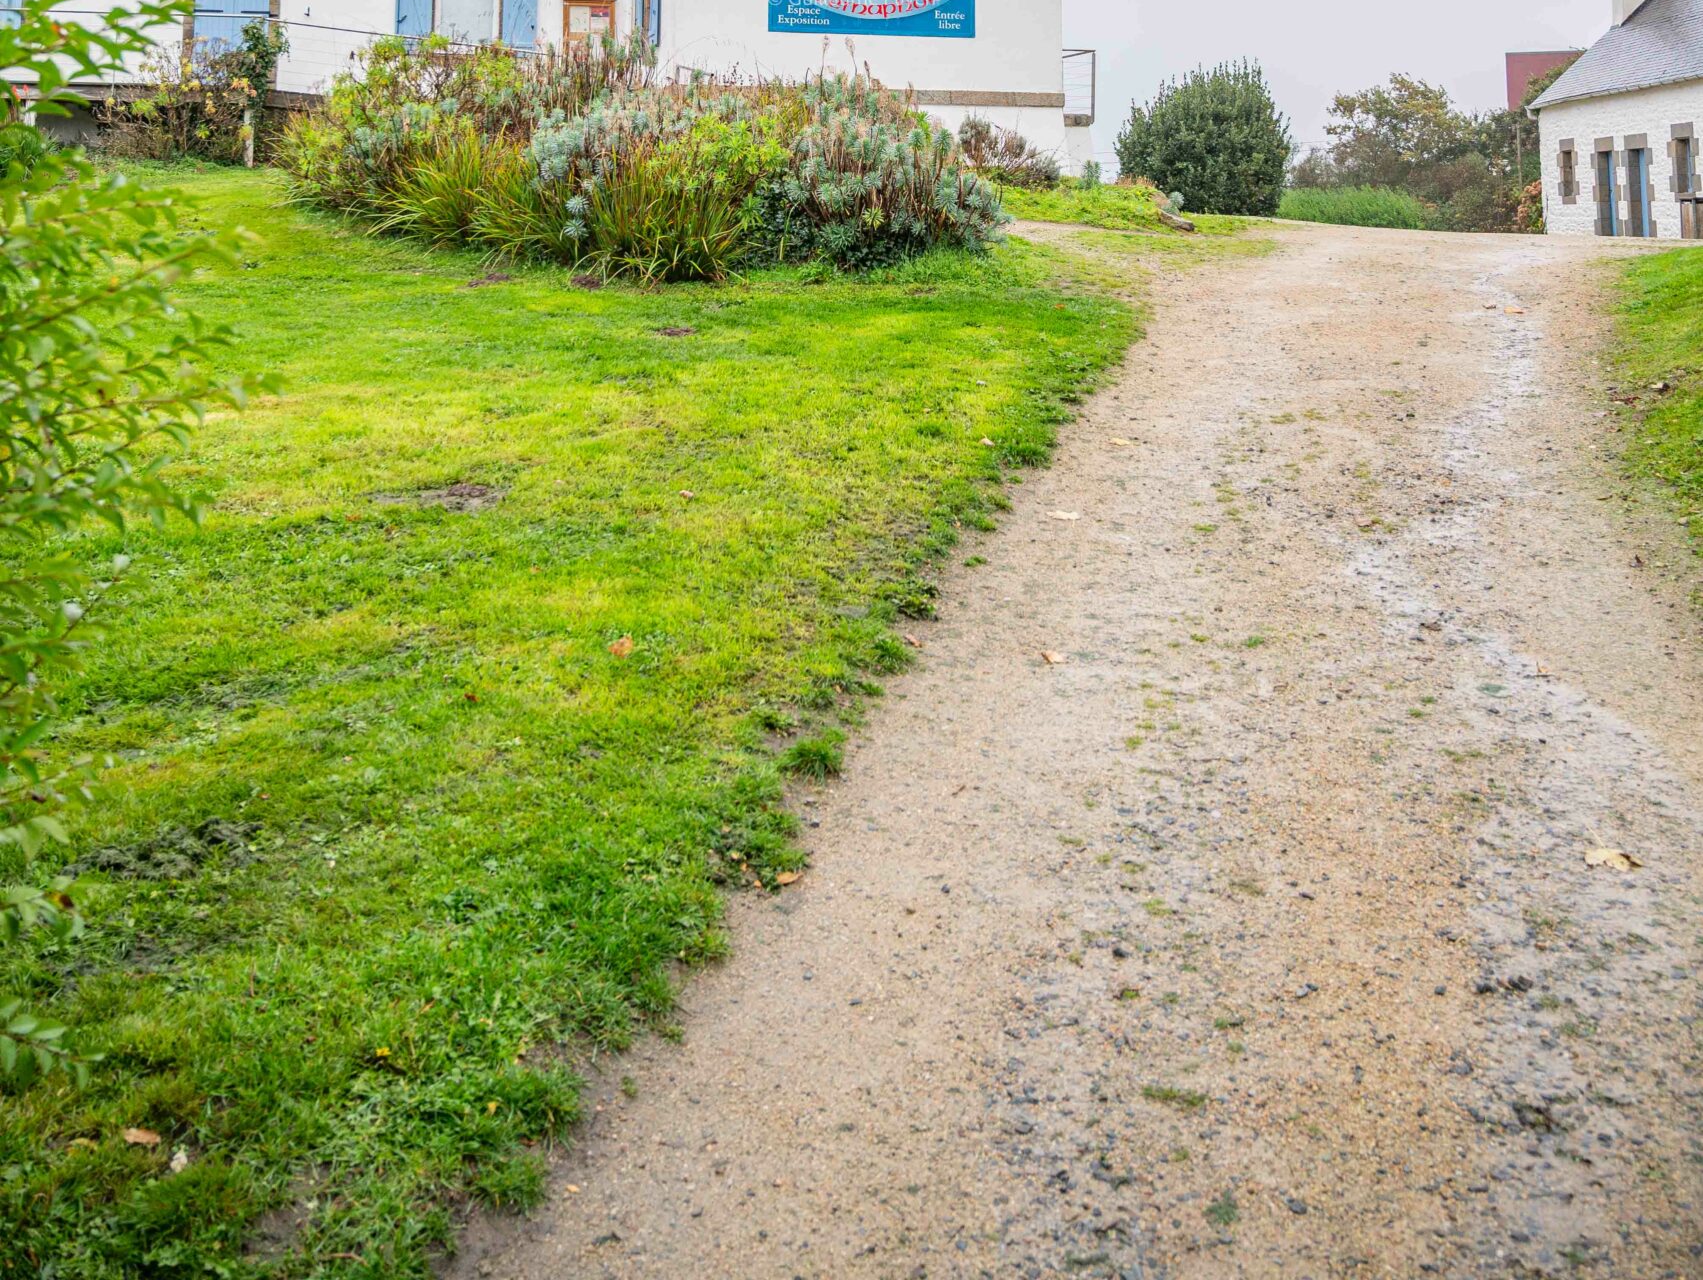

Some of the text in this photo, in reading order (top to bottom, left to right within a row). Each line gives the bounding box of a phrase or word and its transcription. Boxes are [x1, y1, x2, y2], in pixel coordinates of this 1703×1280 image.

[787, 4, 821, 17] Espace
[934, 9, 966, 20] Entrée
[777, 14, 830, 26] Exposition
[938, 19, 961, 30] libre
